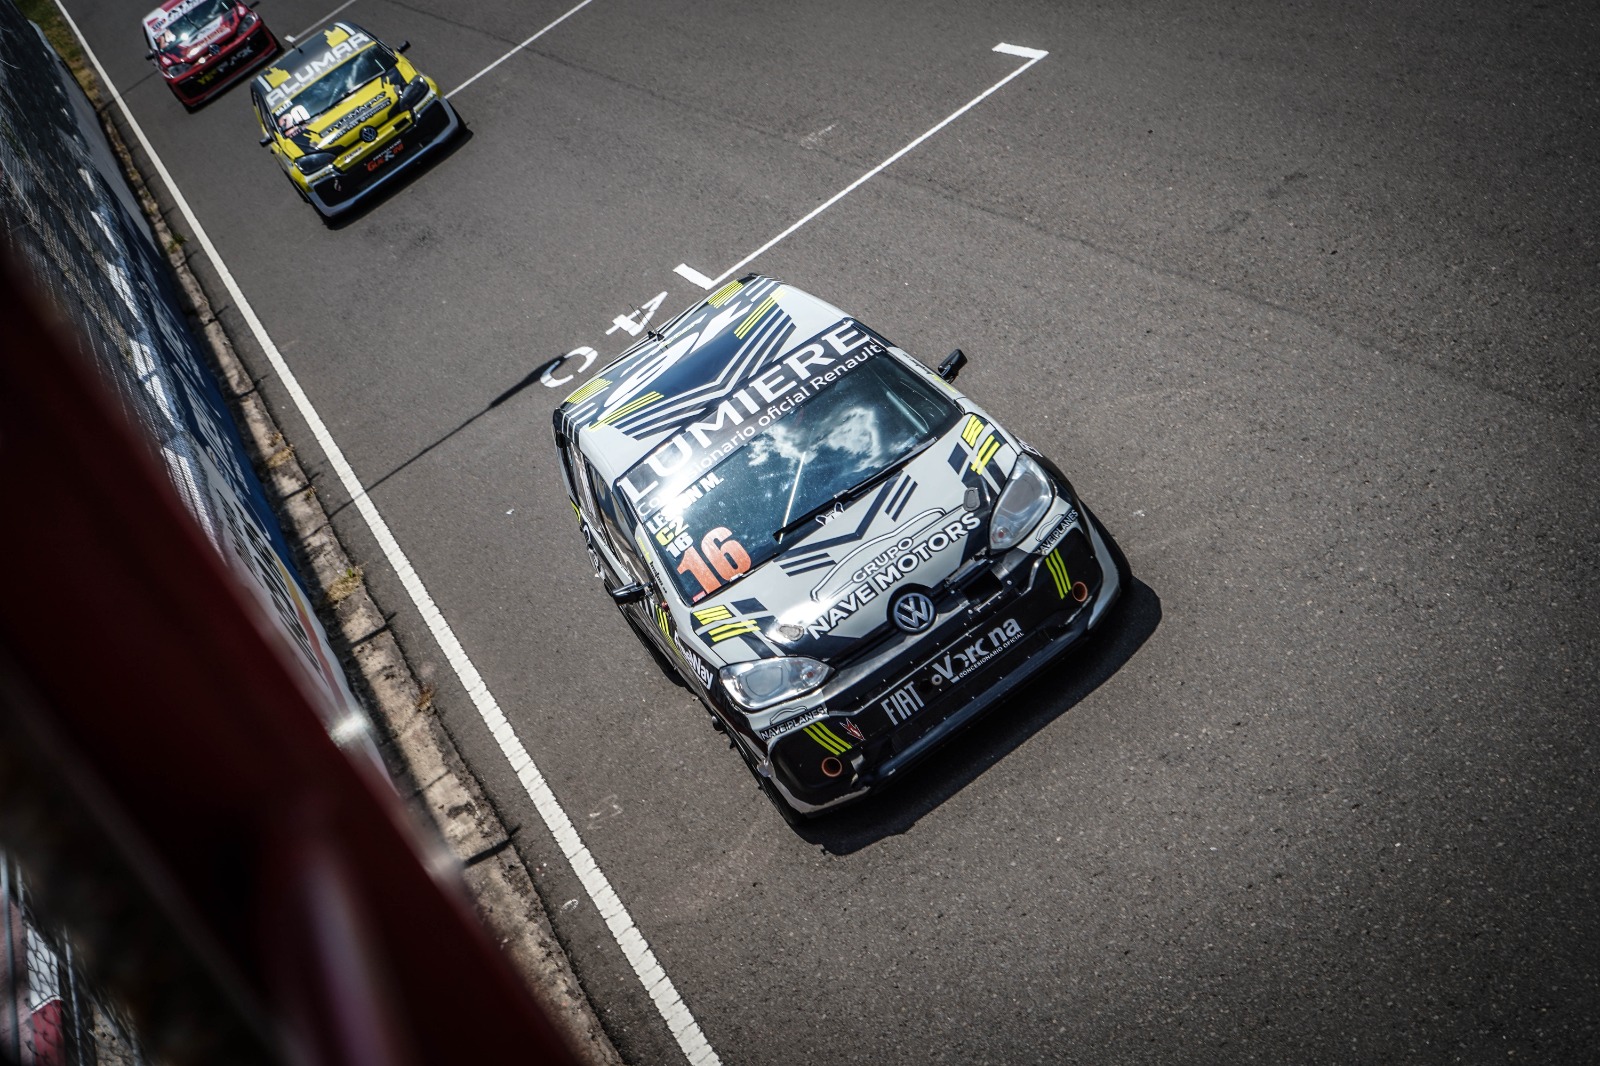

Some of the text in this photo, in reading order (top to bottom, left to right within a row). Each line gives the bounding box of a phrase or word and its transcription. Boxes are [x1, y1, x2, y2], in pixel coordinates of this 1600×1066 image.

[265, 31, 370, 106] ALUMAR
[278, 104, 310, 136] 20
[616, 320, 869, 501] LUMIERE
[637, 423, 755, 517] Cosionario
[758, 385, 809, 427] oficial
[811, 343, 880, 391] Renault
[700, 472, 724, 491] M.
[655, 515, 689, 546] C2
[664, 531, 694, 558] 16
[677, 526, 752, 597] 16
[807, 511, 980, 639] NAVE MOTORS
[851, 536, 914, 582] GRUPO
[959, 631, 1024, 678] CONCESIONARIO OFICIAL
[880, 681, 925, 725] FIAT
